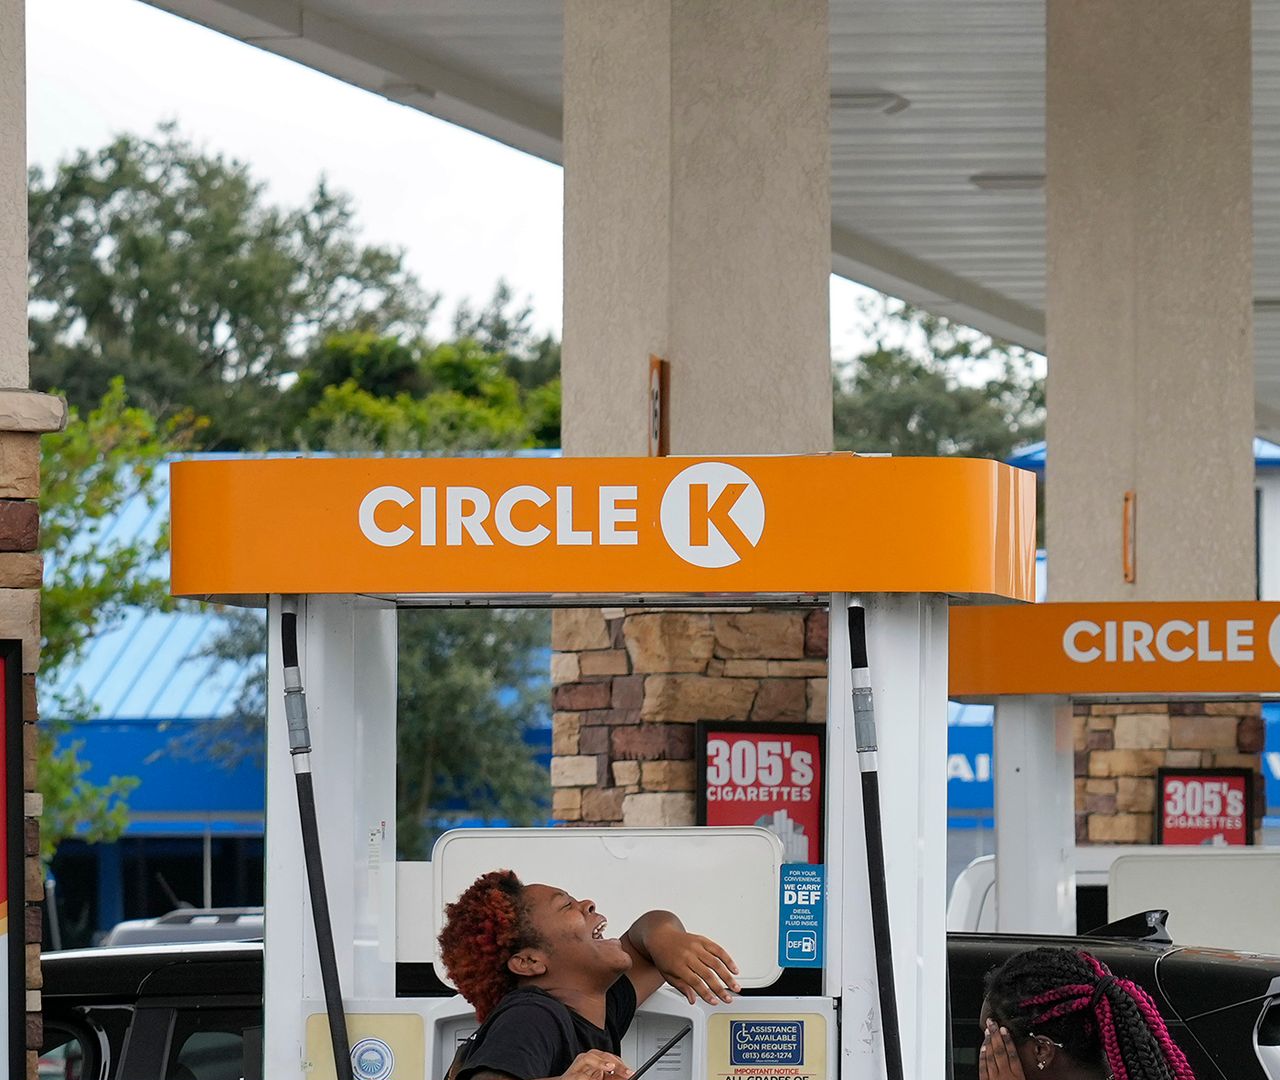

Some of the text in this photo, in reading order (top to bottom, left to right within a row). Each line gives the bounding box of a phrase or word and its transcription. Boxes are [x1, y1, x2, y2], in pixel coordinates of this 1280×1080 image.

[358, 485, 638, 547] CIRCLE
[1062, 619, 1254, 663] CIRCLE
[706, 740, 814, 786] 305's
[706, 787, 812, 801] CIGARETTES
[1165, 781, 1243, 817] 305's
[1165, 816, 1242, 829] CIGARETTES
[784, 891, 821, 905] DEF
[788, 940, 802, 948] DEF
[761, 1043, 797, 1051] REQUEST
